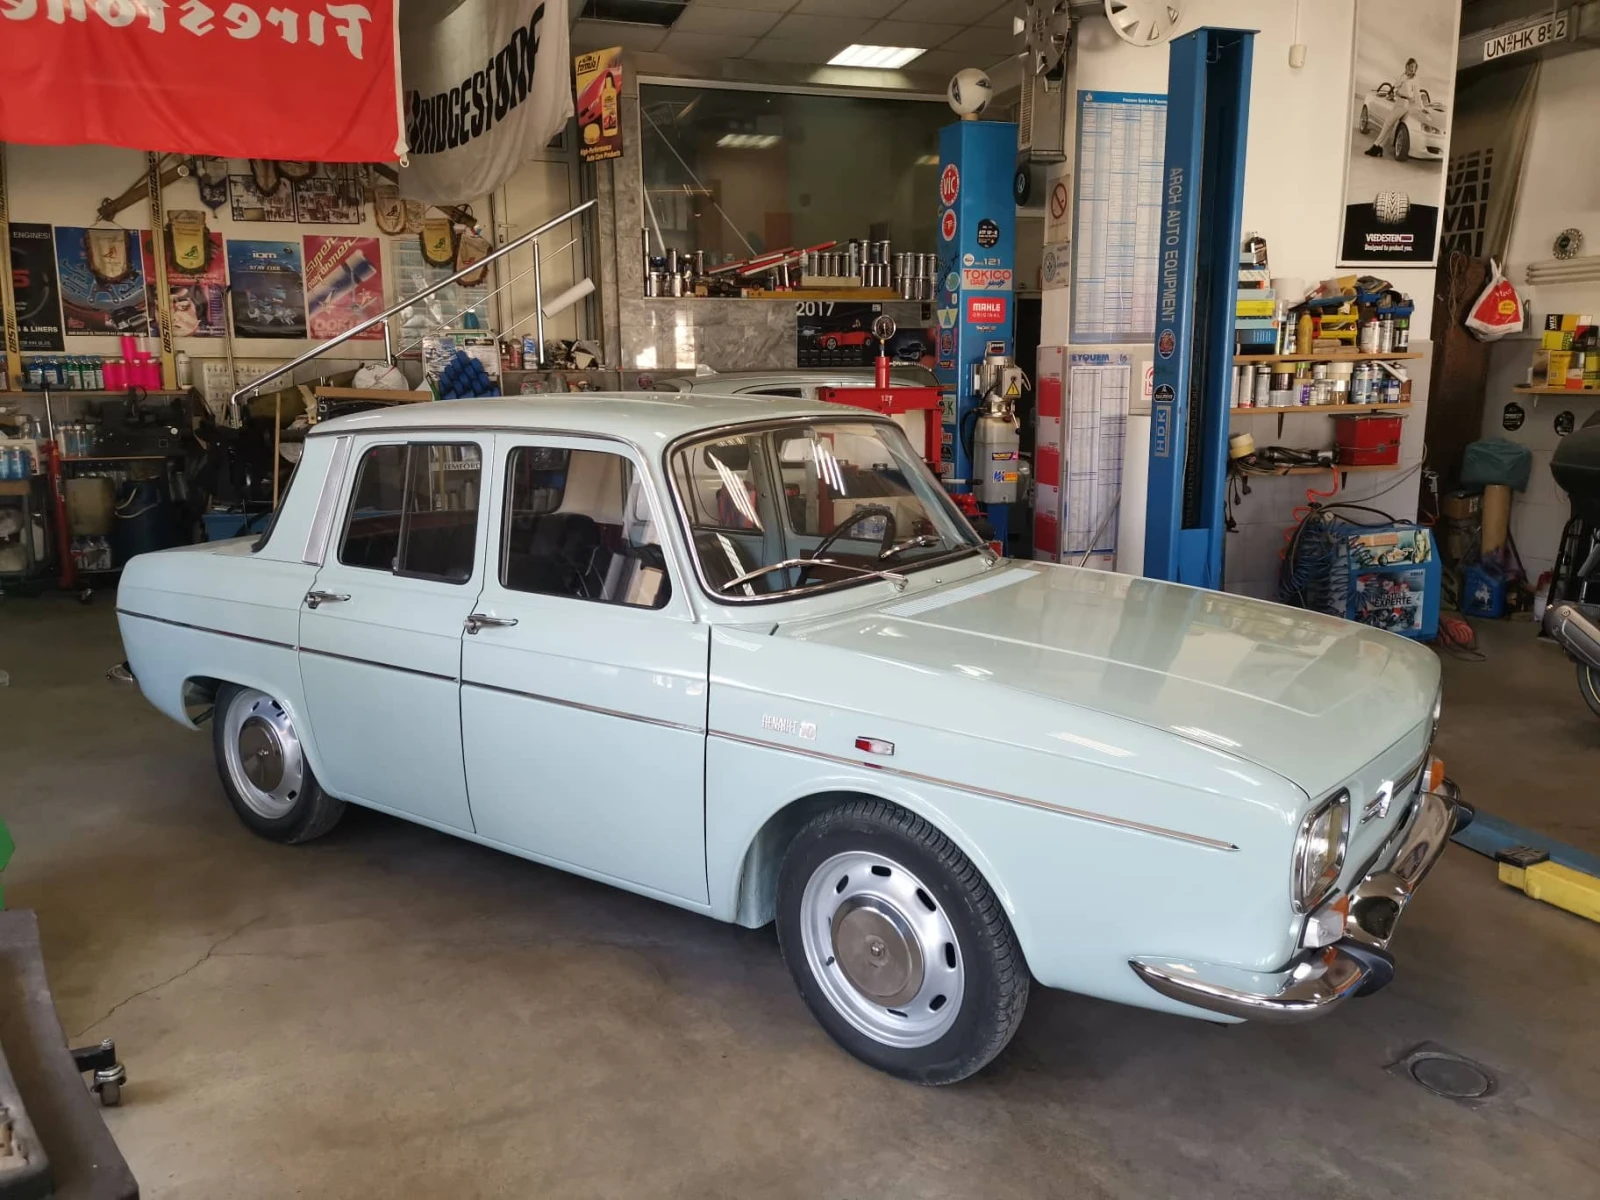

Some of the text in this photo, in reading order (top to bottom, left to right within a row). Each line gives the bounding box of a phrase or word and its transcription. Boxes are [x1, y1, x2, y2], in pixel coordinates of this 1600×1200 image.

[1486, 36, 1506, 58] UN
[1512, 28, 1534, 51] HK
[403, 2, 545, 155] BRIDGESTONE
[1162, 167, 1183, 323] ARCH AUTO EQUIPMENT
[963, 269, 1011, 280] TOKICO
[795, 301, 835, 317] 2017
[972, 303, 1001, 312] MAHLE
[30, 325, 58, 333] LINERS
[1549, 315, 1557, 330] WIX
[1072, 354, 1110, 363] EYQUEM
[1156, 411, 1167, 451] HDK
[762, 715, 798, 735] RENAULT
